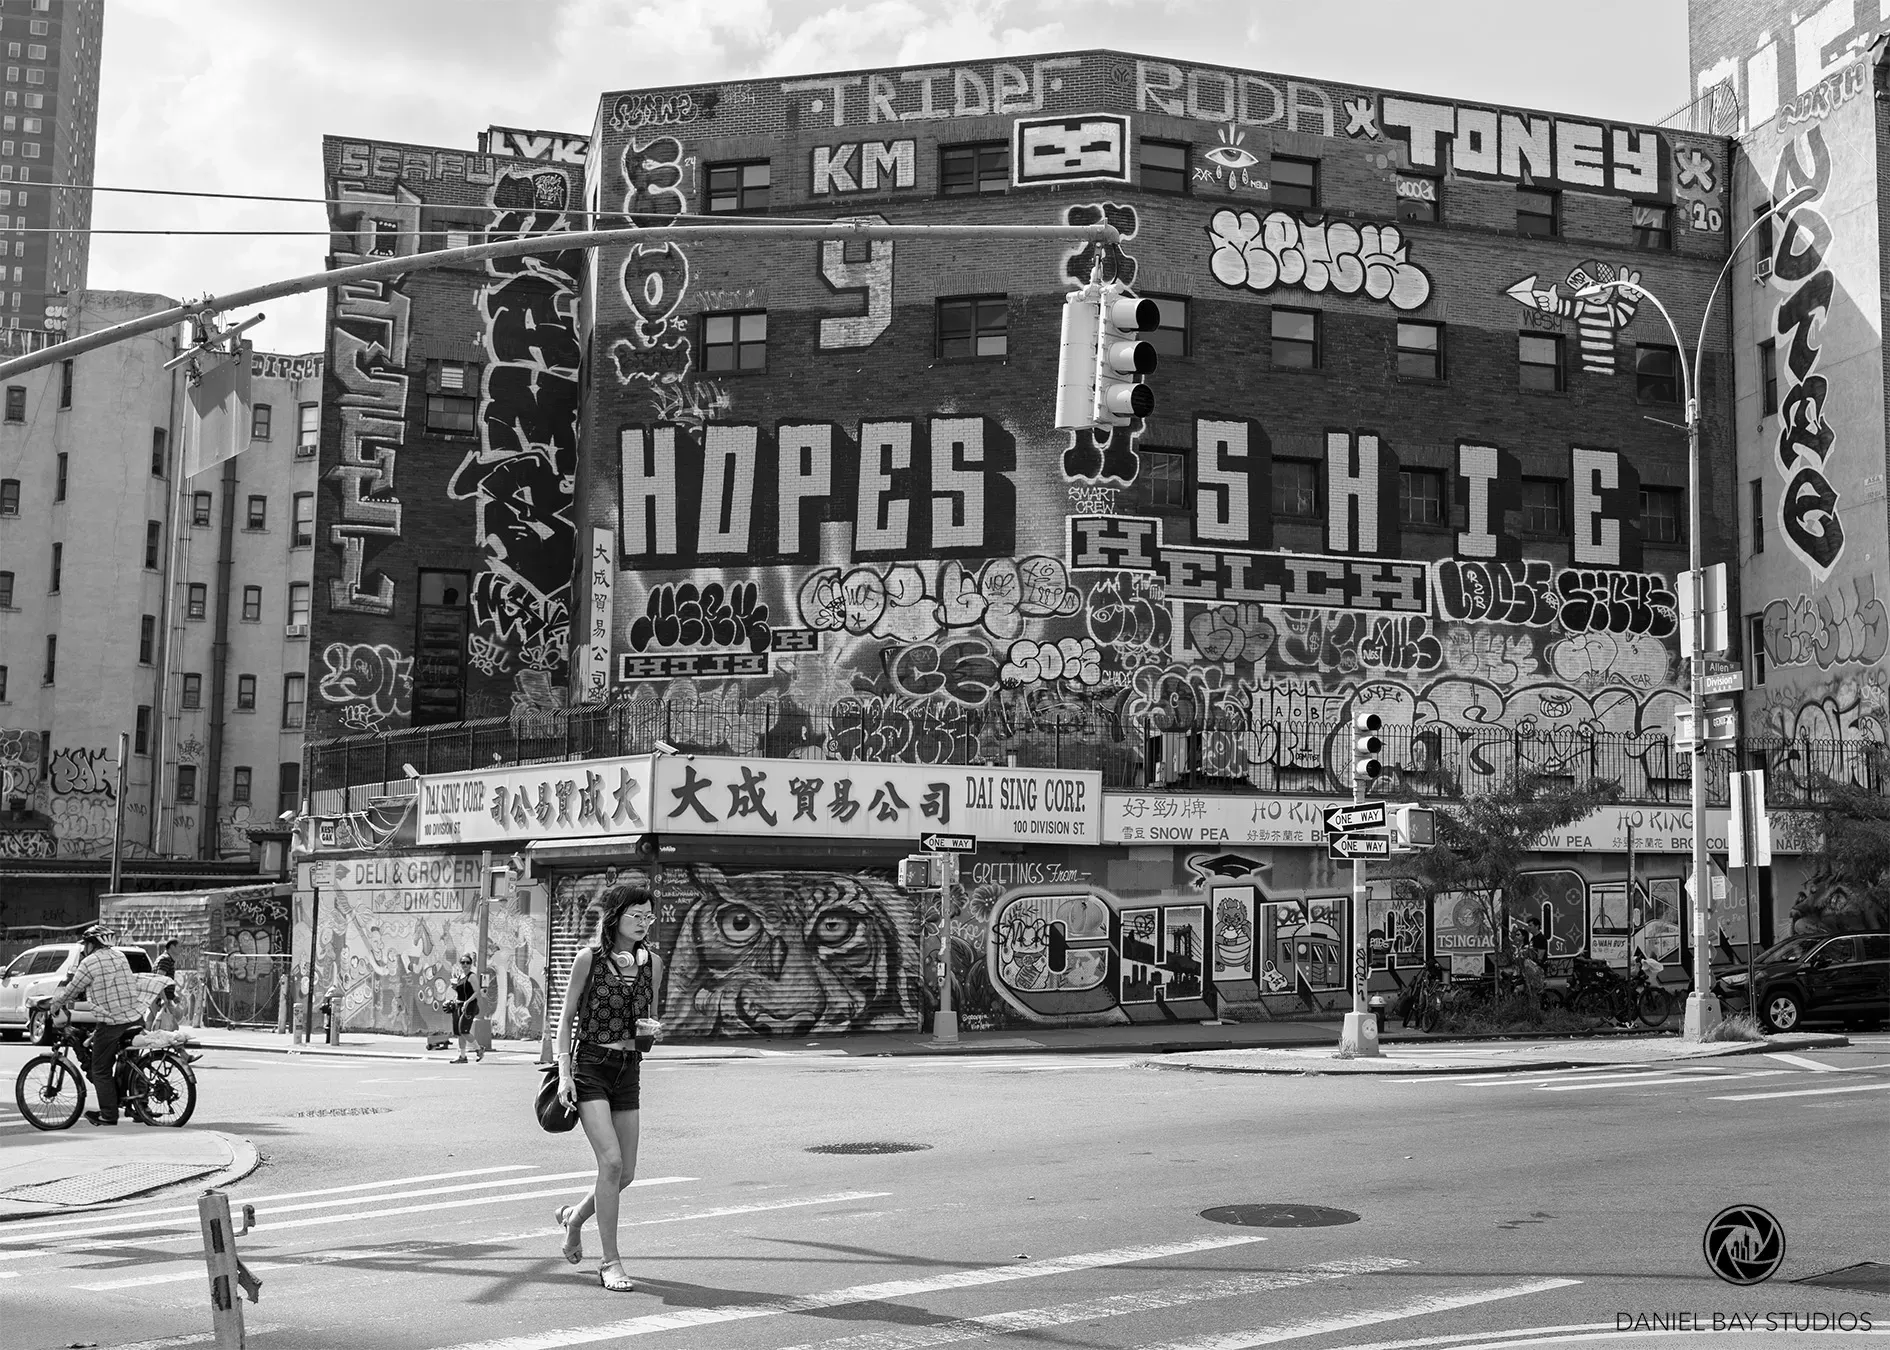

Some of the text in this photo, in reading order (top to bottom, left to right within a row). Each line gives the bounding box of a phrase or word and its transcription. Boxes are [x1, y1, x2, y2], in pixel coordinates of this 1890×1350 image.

[1384, 98, 1658, 193] TONEY
[813, 140, 914, 193] KM
[621, 417, 985, 554] HOPES
[1068, 487, 1121, 501] SMART
[1709, 662, 1729, 672] Allen
[1706, 676, 1733, 687] Division
[425, 783, 440, 815] DAI
[440, 781, 460, 814] SING
[667, 765, 951, 827] 大成貿易公司
[966, 776, 1086, 812] DAI SING CORP.
[1251, 800, 1282, 823] HO
[1335, 811, 1379, 826] ONE WAY
[1616, 810, 1643, 831] HO
[424, 824, 432, 836] 100
[432, 823, 453, 836] DIVISION
[1013, 821, 1085, 835] 100 DIVISION ST.
[1150, 827, 1229, 841] SNOW PEA
[929, 839, 969, 848] ONE WAY
[1341, 841, 1384, 852] ONE WAY
[1567, 836, 1593, 848] PEA
[356, 863, 387, 884] DELI
[393, 862, 403, 884] &
[408, 860, 481, 884] GROCERY
[973, 863, 1044, 884] GREETINGS
[404, 891, 459, 911] DIM SUM
